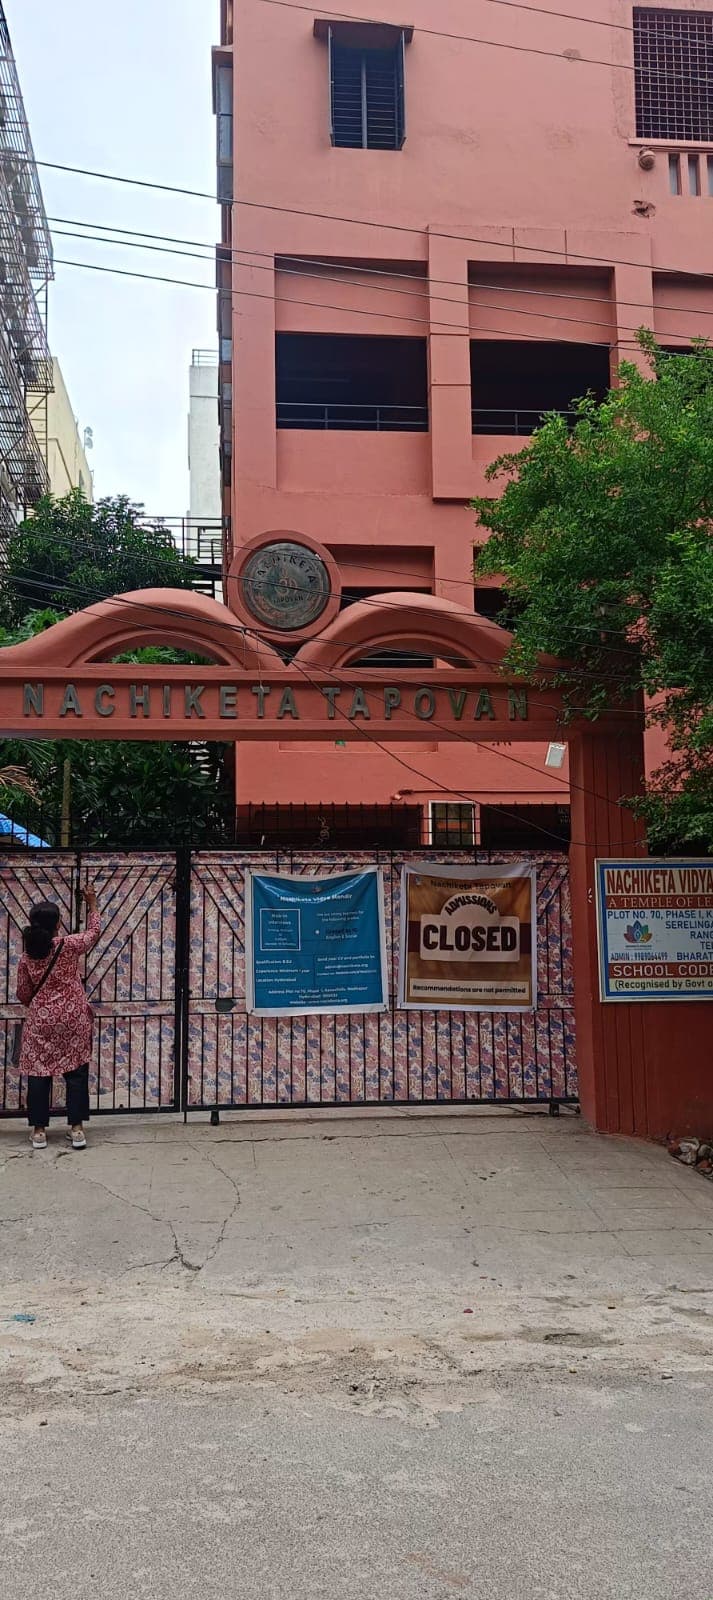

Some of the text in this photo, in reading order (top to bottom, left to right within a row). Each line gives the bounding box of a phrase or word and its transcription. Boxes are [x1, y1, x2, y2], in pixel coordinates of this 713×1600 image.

[22, 683, 528, 720] NACHIKETA TAPOVAN
[606, 869, 713, 894] NACHIKETA VIDYA
[444, 894, 498, 916] ADMISSIONS
[608, 896, 713, 908] A TEMPLE OF LE
[607, 910, 631, 920] PLOT
[632, 910, 648, 920] NO.
[650, 910, 664, 921] 70,
[665, 910, 696, 919] PHASE
[706, 910, 713, 919] K
[422, 924, 517, 951] CLOSED
[700, 941, 713, 950] TE
[613, 965, 674, 977] SCHOOL
[412, 984, 526, 995] Recommendations are not permitted
[614, 979, 670, 991] (Recognised
[672, 979, 683, 990] by
[685, 979, 705, 988] Govt
